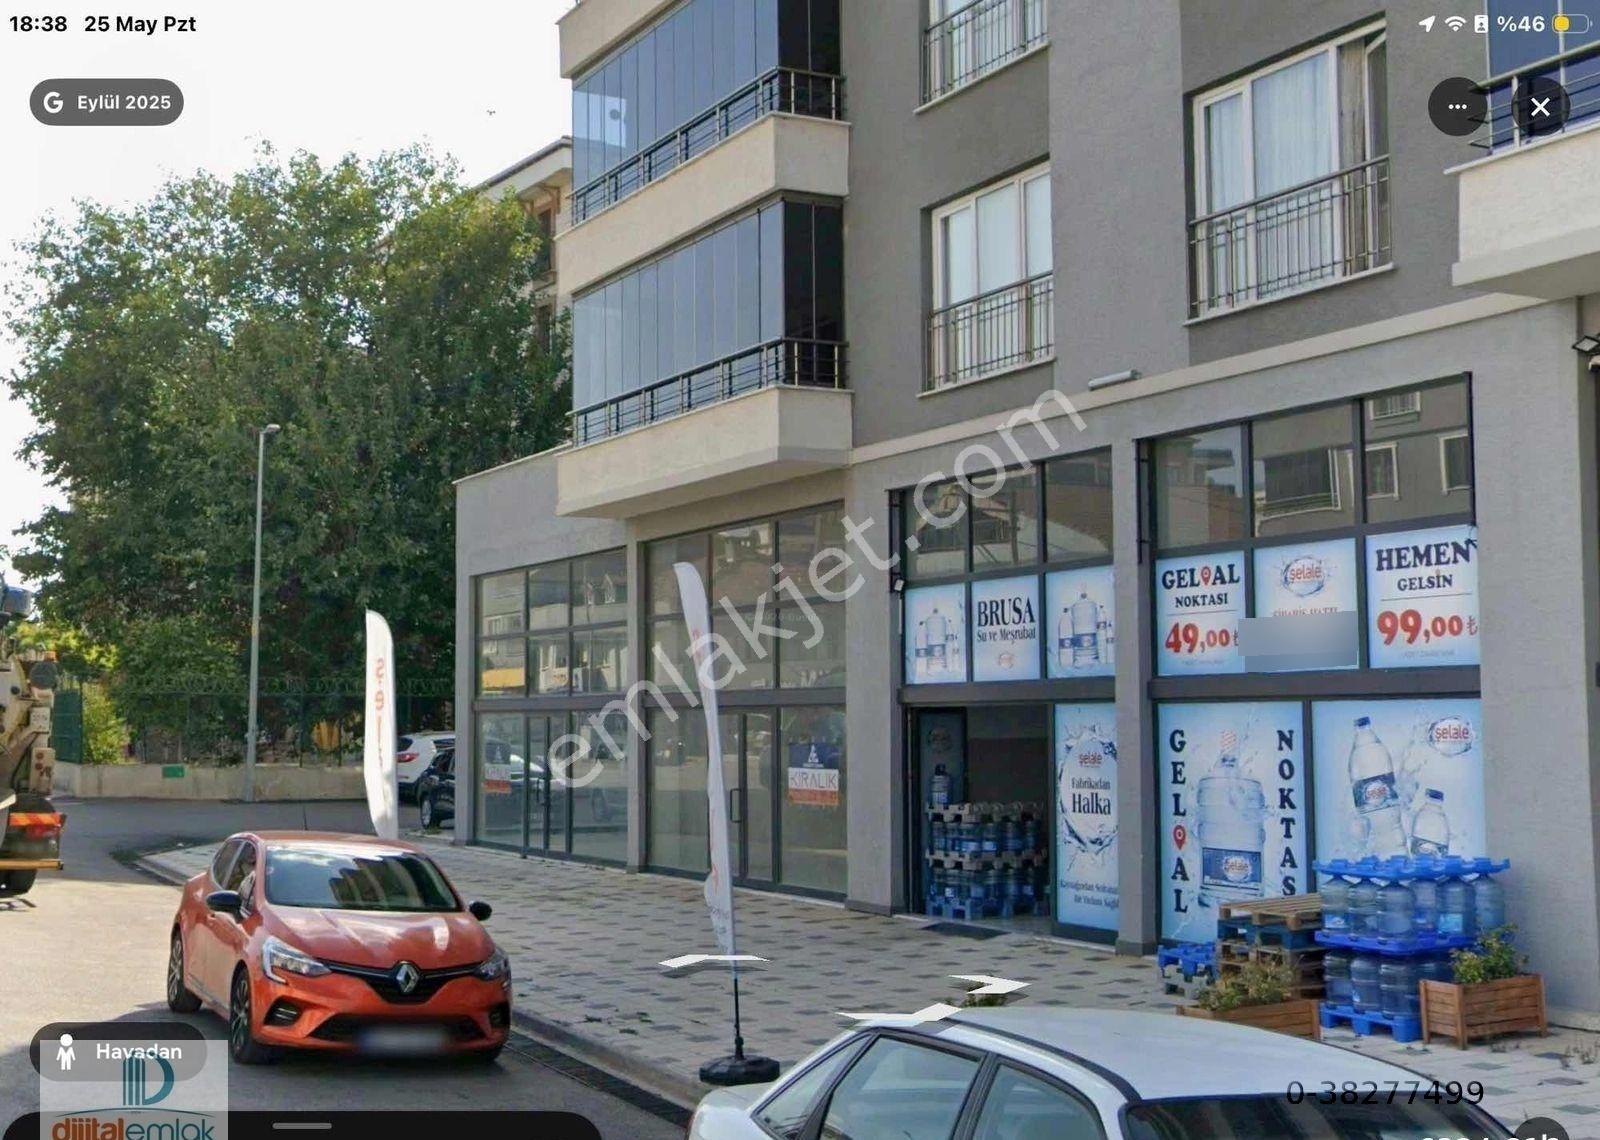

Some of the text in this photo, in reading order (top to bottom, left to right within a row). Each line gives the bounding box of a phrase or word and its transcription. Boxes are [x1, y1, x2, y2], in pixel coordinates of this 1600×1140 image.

[1376, 540, 1476, 571] HEMEN
[1397, 568, 1453, 591] GELSİN
[978, 597, 1035, 627] BRUSA
[1175, 593, 1228, 608] NOKTASI
[789, 771, 837, 789] KIRALIK
[1072, 792, 1111, 815] Halka
[1277, 729, 1298, 896] NOKTAS
